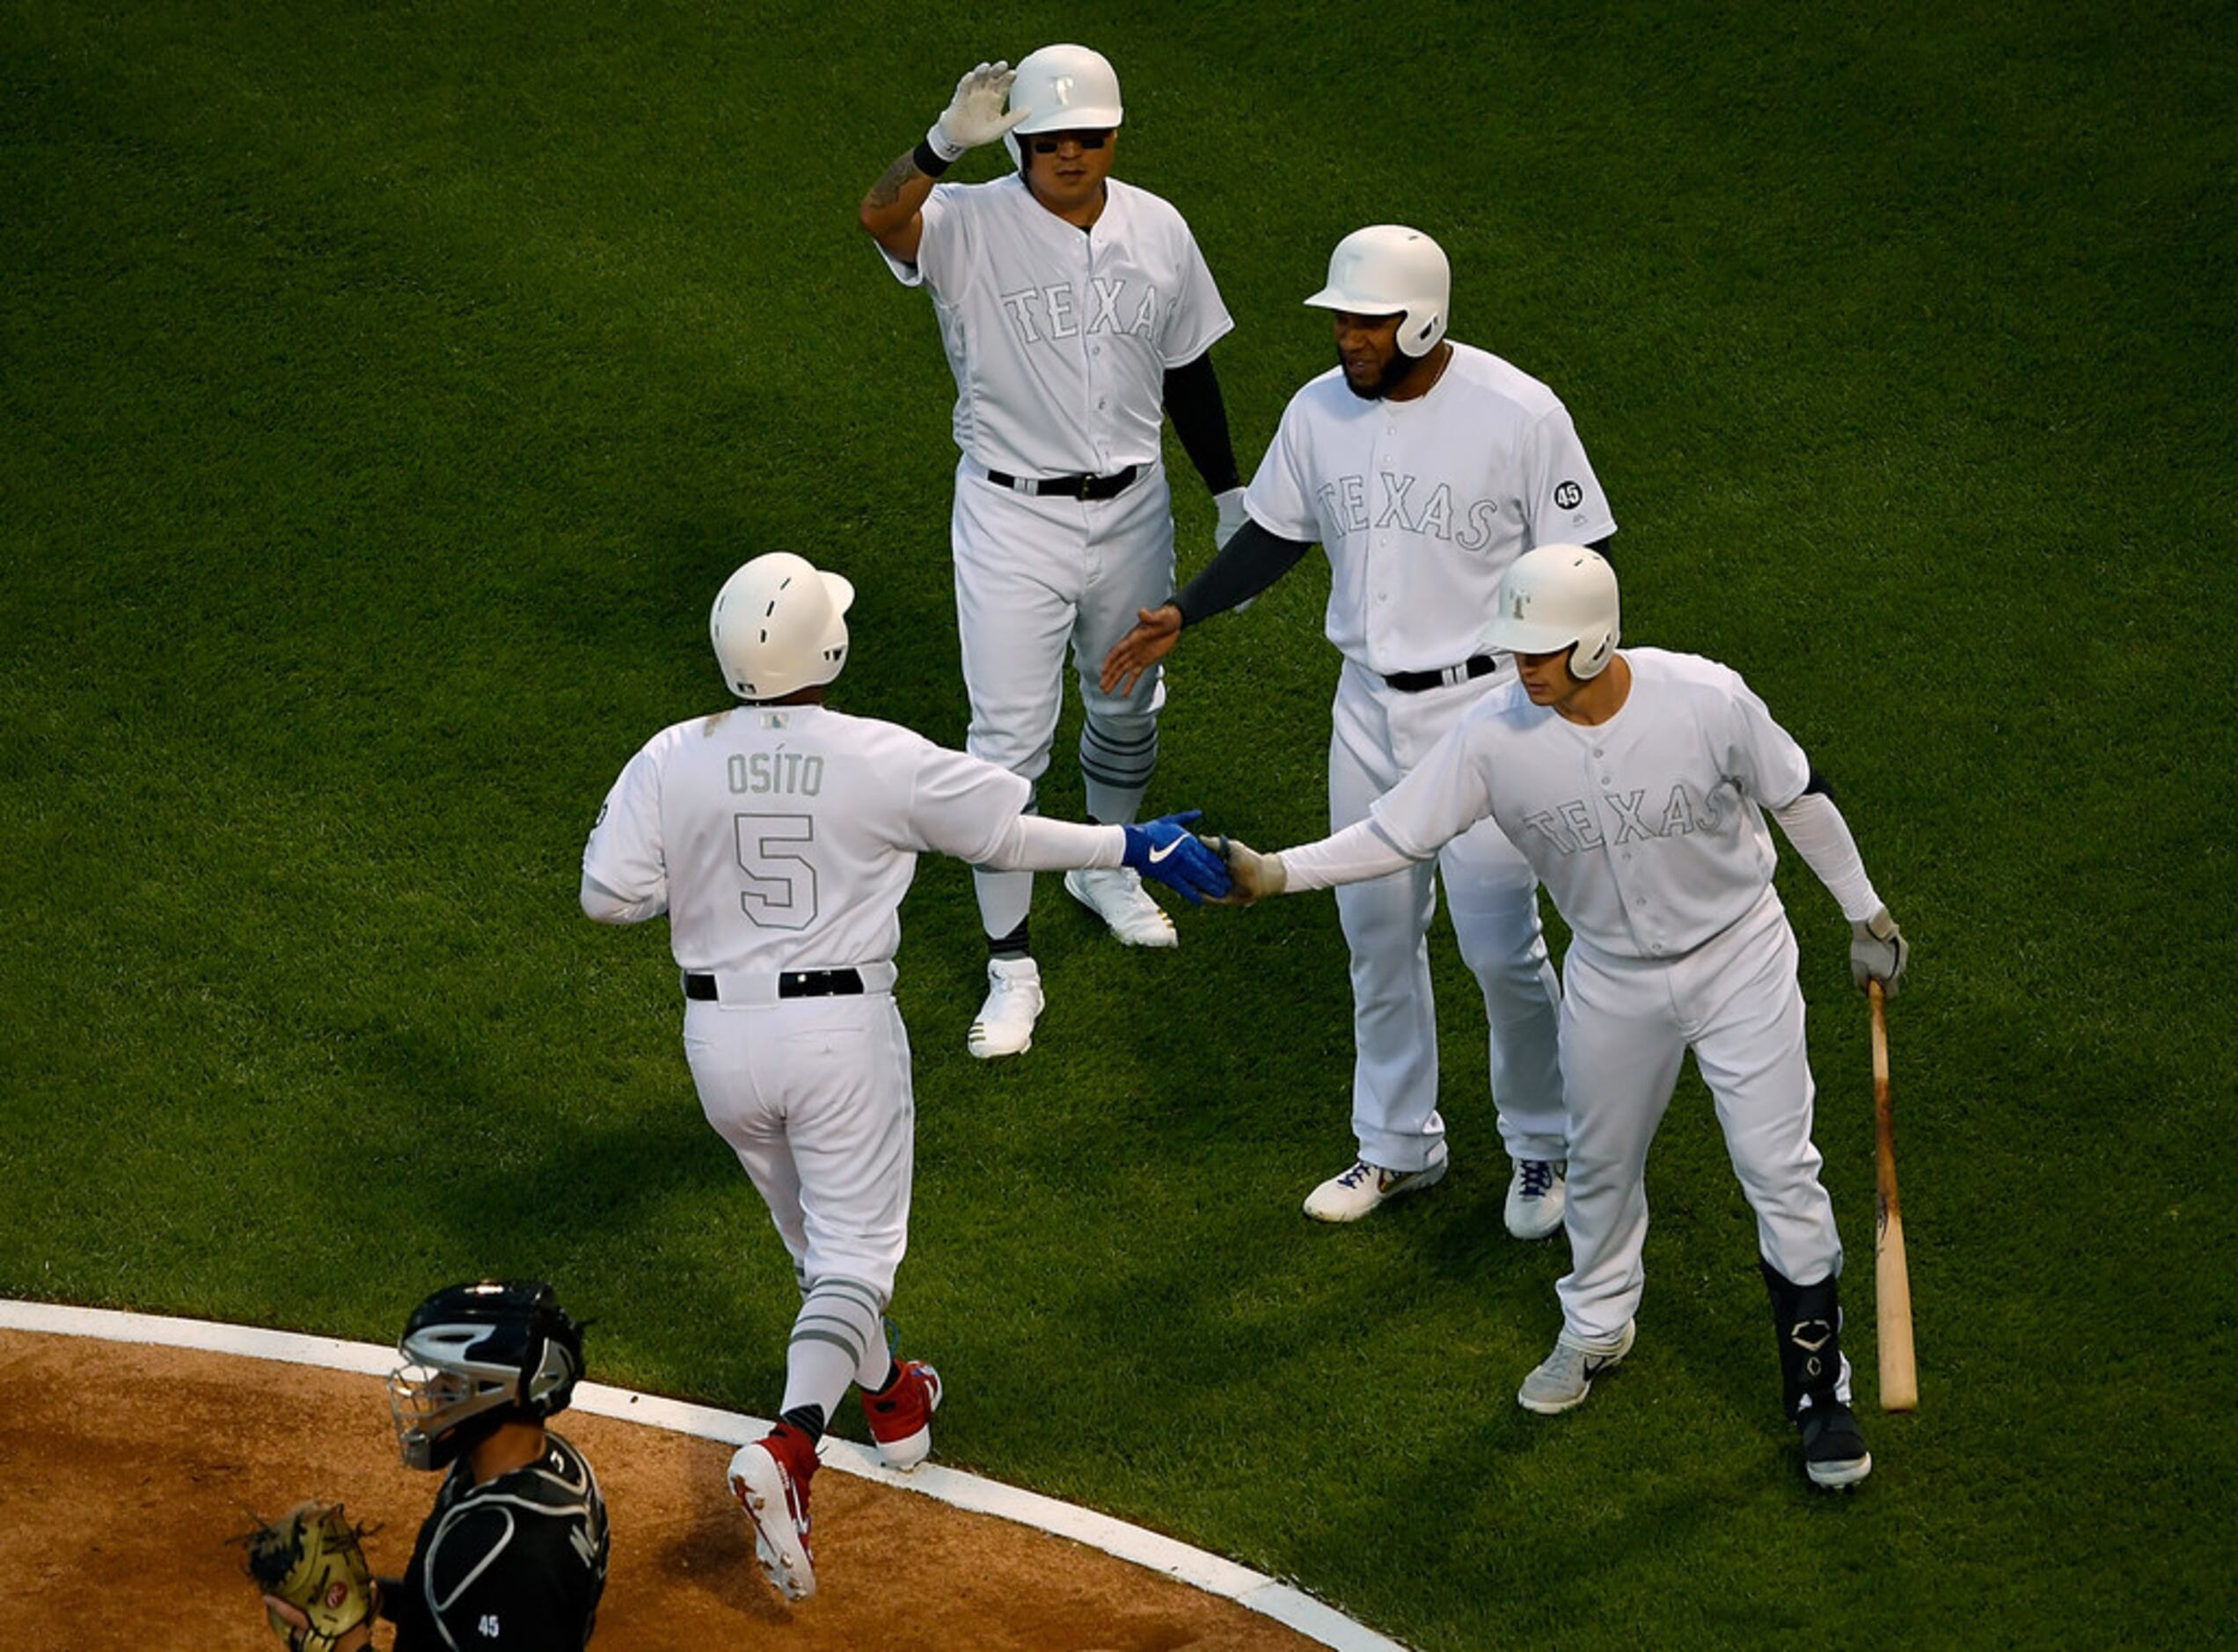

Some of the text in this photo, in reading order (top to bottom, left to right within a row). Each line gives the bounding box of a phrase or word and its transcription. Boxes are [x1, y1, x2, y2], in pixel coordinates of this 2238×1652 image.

[1000, 277, 1176, 343] TEXA
[1319, 471, 1497, 552] TEXAS
[1558, 485, 1580, 507] 45
[728, 743, 823, 796] OSÍTO
[734, 813, 818, 932] 5
[479, 1614, 500, 1637] 45
